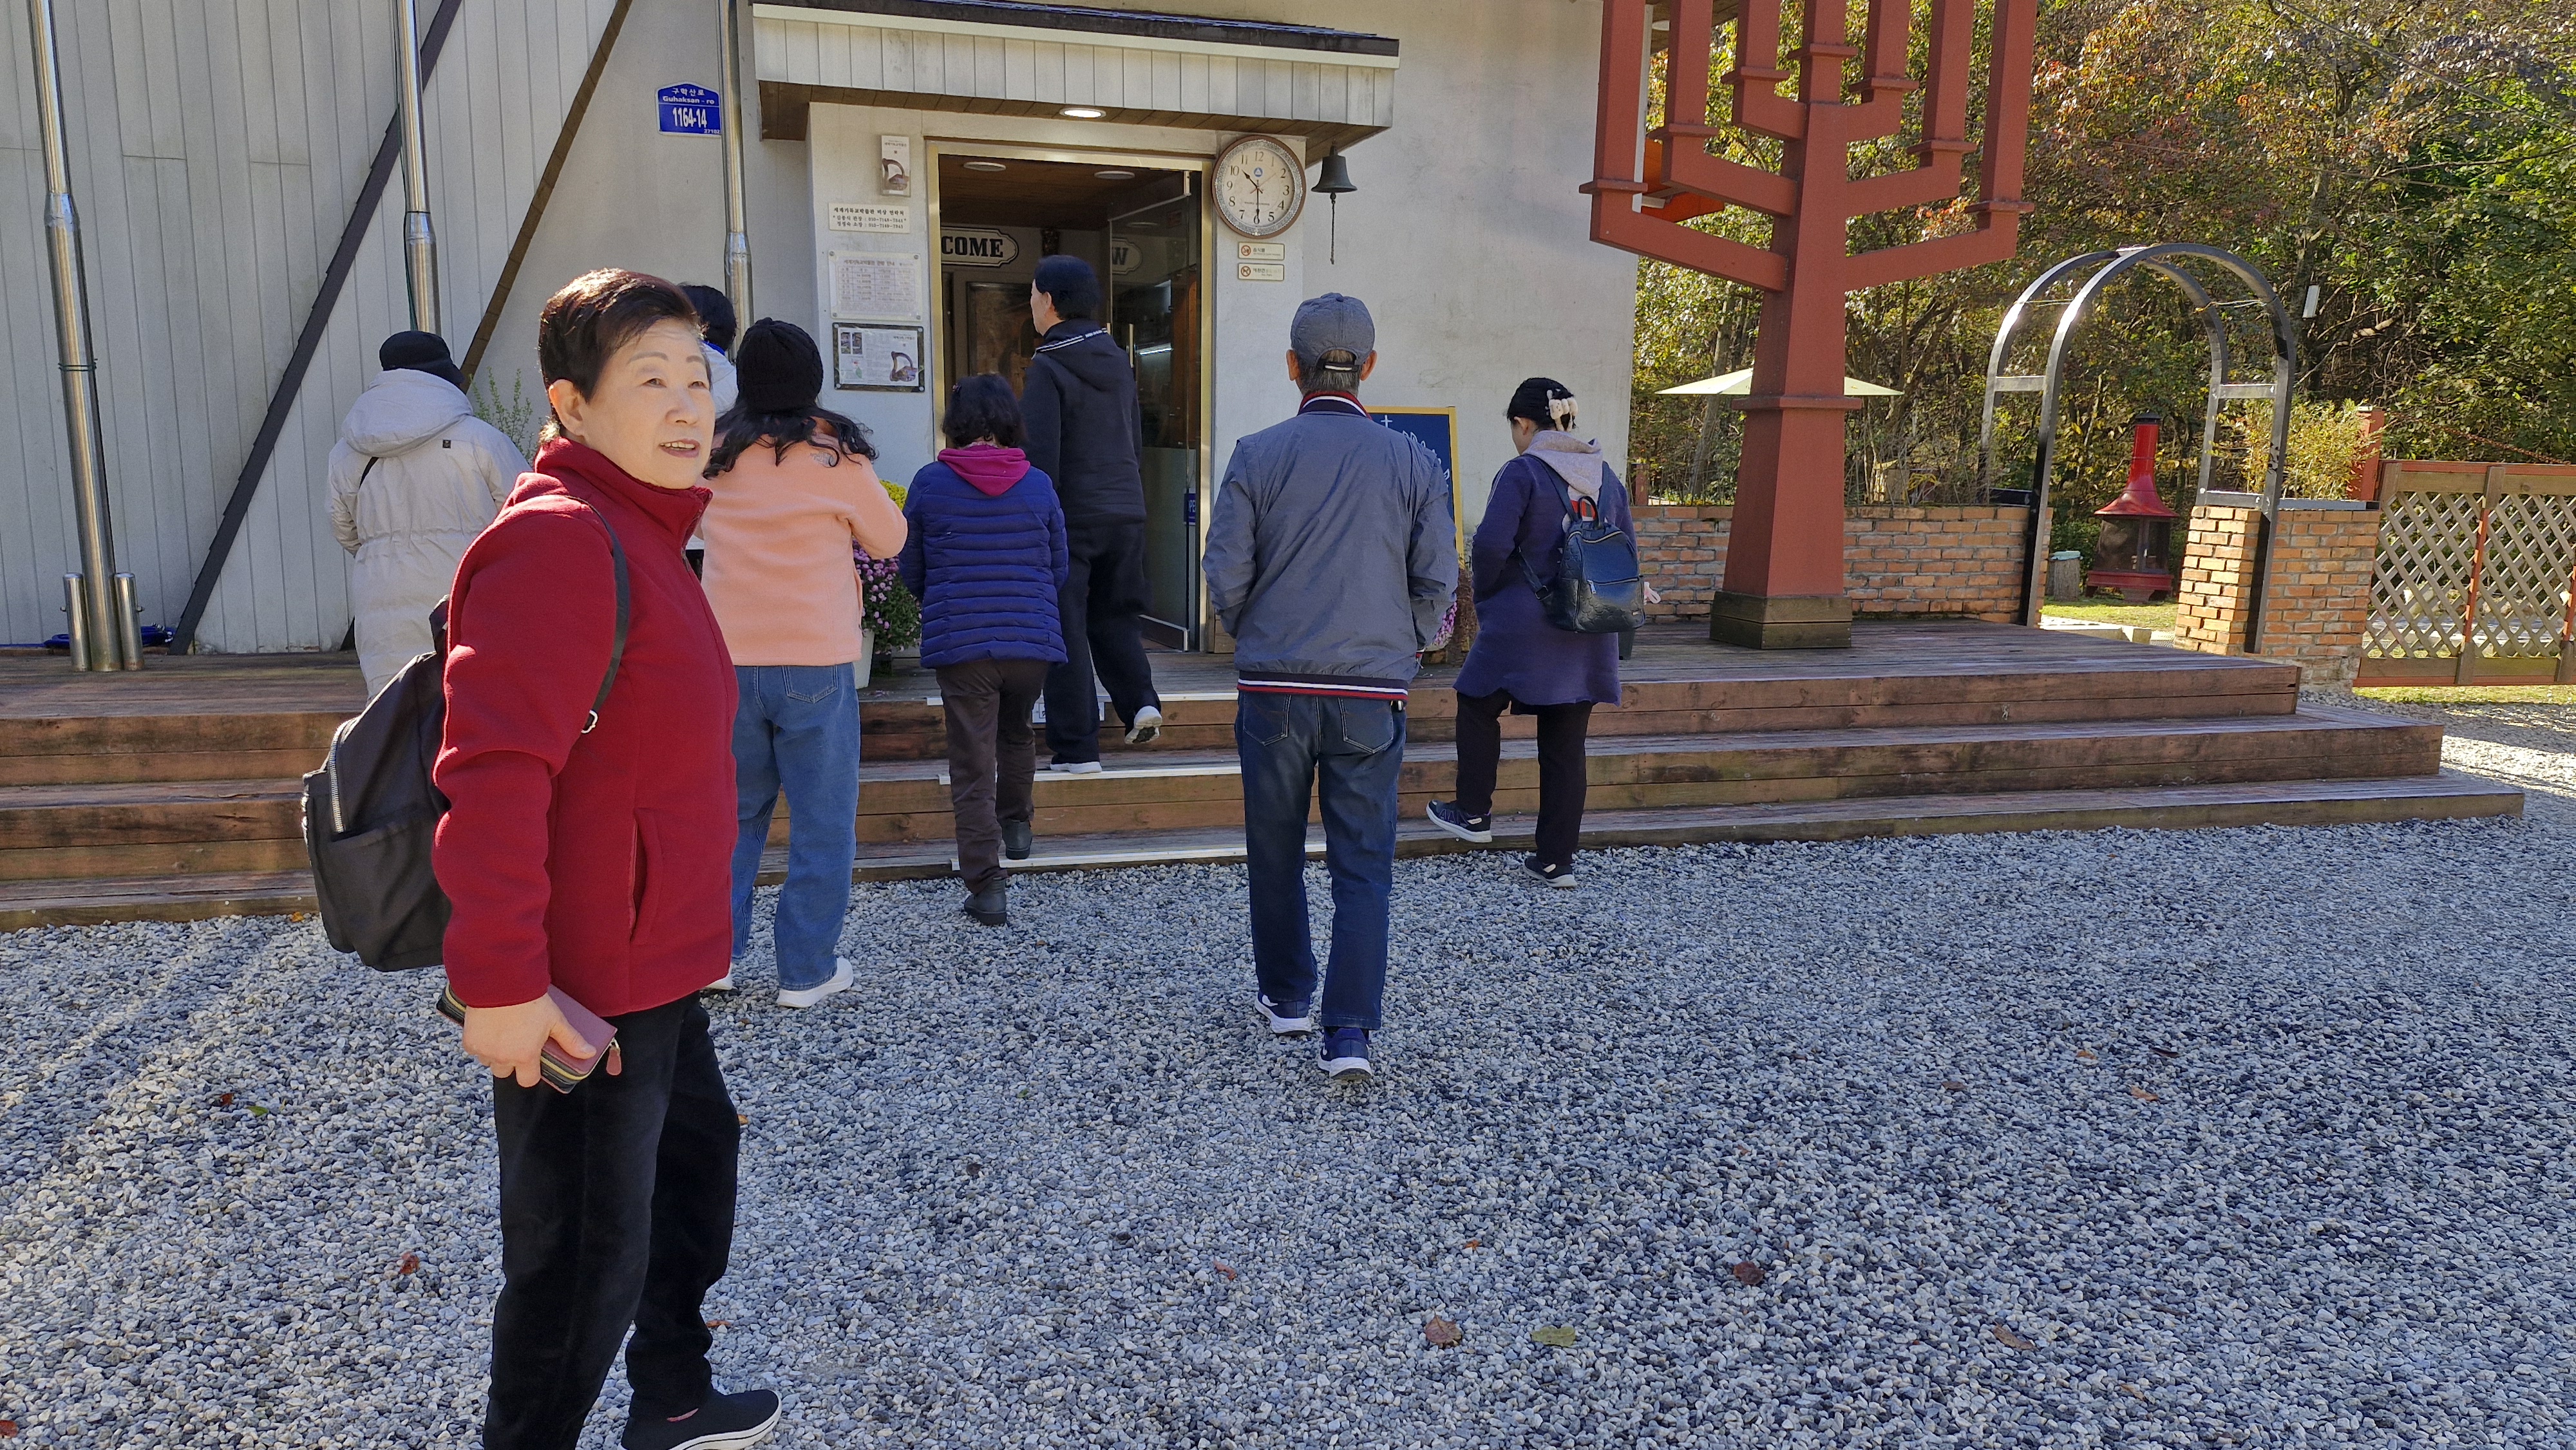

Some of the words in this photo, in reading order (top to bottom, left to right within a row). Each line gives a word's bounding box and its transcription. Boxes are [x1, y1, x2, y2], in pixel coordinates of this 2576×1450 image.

[672, 88, 705, 97] 구학산로
[672, 107, 708, 128] 1164-14
[1241, 155, 1248, 165] 11
[1255, 151, 1264, 162] 12
[1271, 156, 1274, 167] 1
[1230, 165, 1240, 176] 10
[1280, 168, 1286, 178] 2
[1226, 180, 1233, 191] 9
[1282, 185, 1290, 196] 3
[1228, 196, 1236, 207] 8
[1277, 200, 1285, 210] 4
[1239, 209, 1245, 220] 7
[1253, 214, 1260, 225] 6
[1267, 211, 1275, 222] 5
[941, 236, 1004, 258] COME
